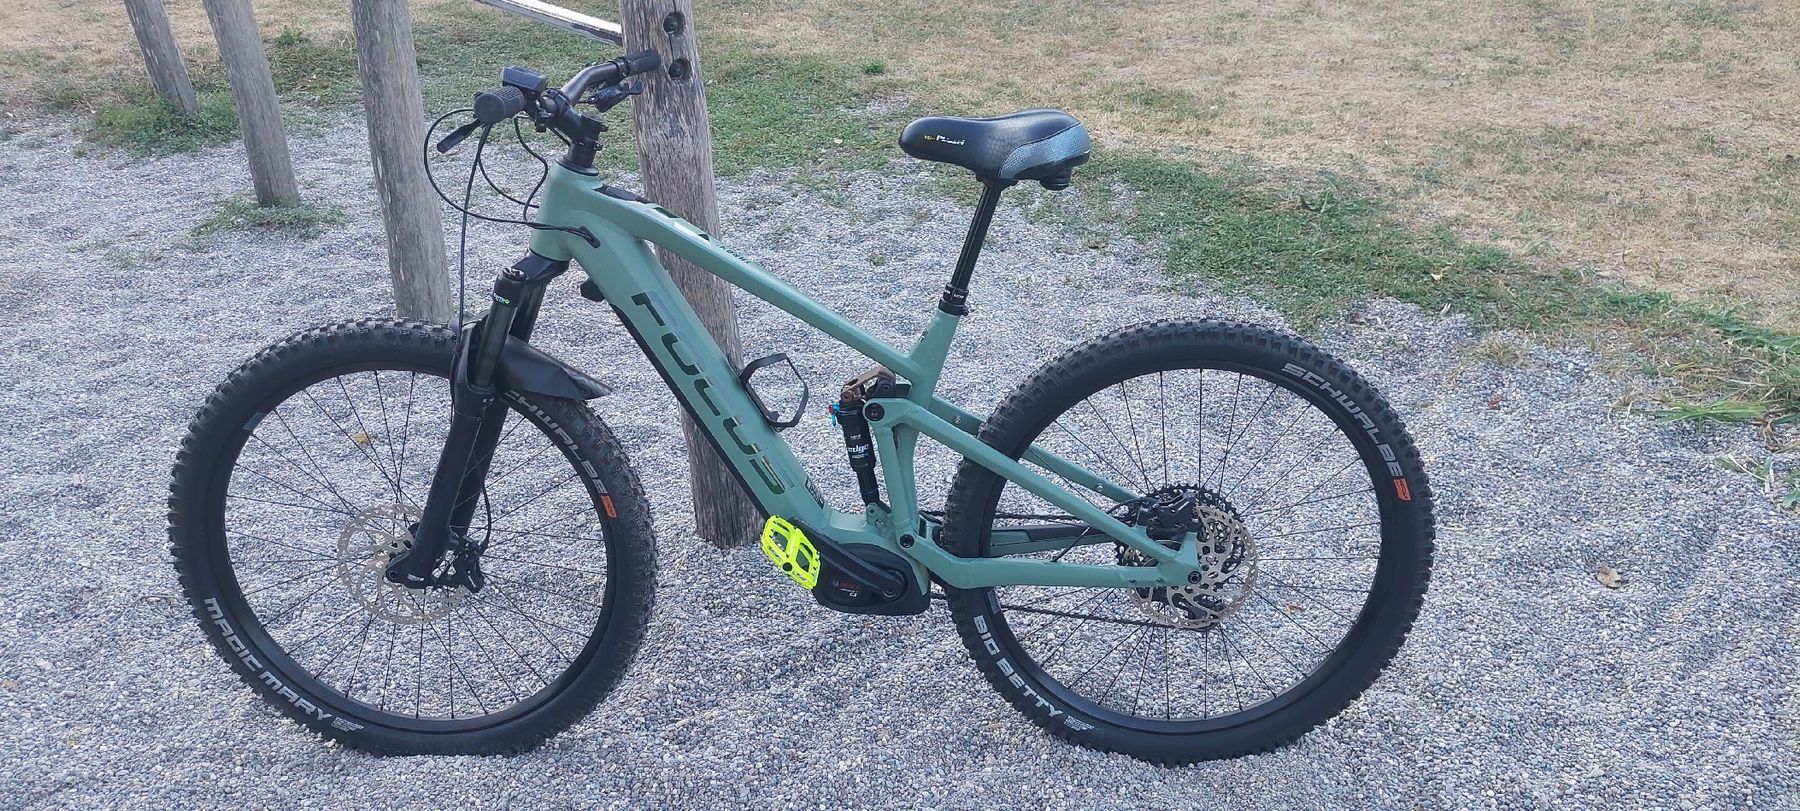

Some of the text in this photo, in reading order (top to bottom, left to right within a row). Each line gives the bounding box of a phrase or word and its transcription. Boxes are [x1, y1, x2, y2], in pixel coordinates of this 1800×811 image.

[504, 390, 608, 494] CHWALBE
[631, 290, 796, 495] FOCUS
[1281, 362, 1404, 477] SCHWALBE
[203, 597, 333, 721] MAGIC MARY
[973, 614, 1064, 718] BIG BETTY
